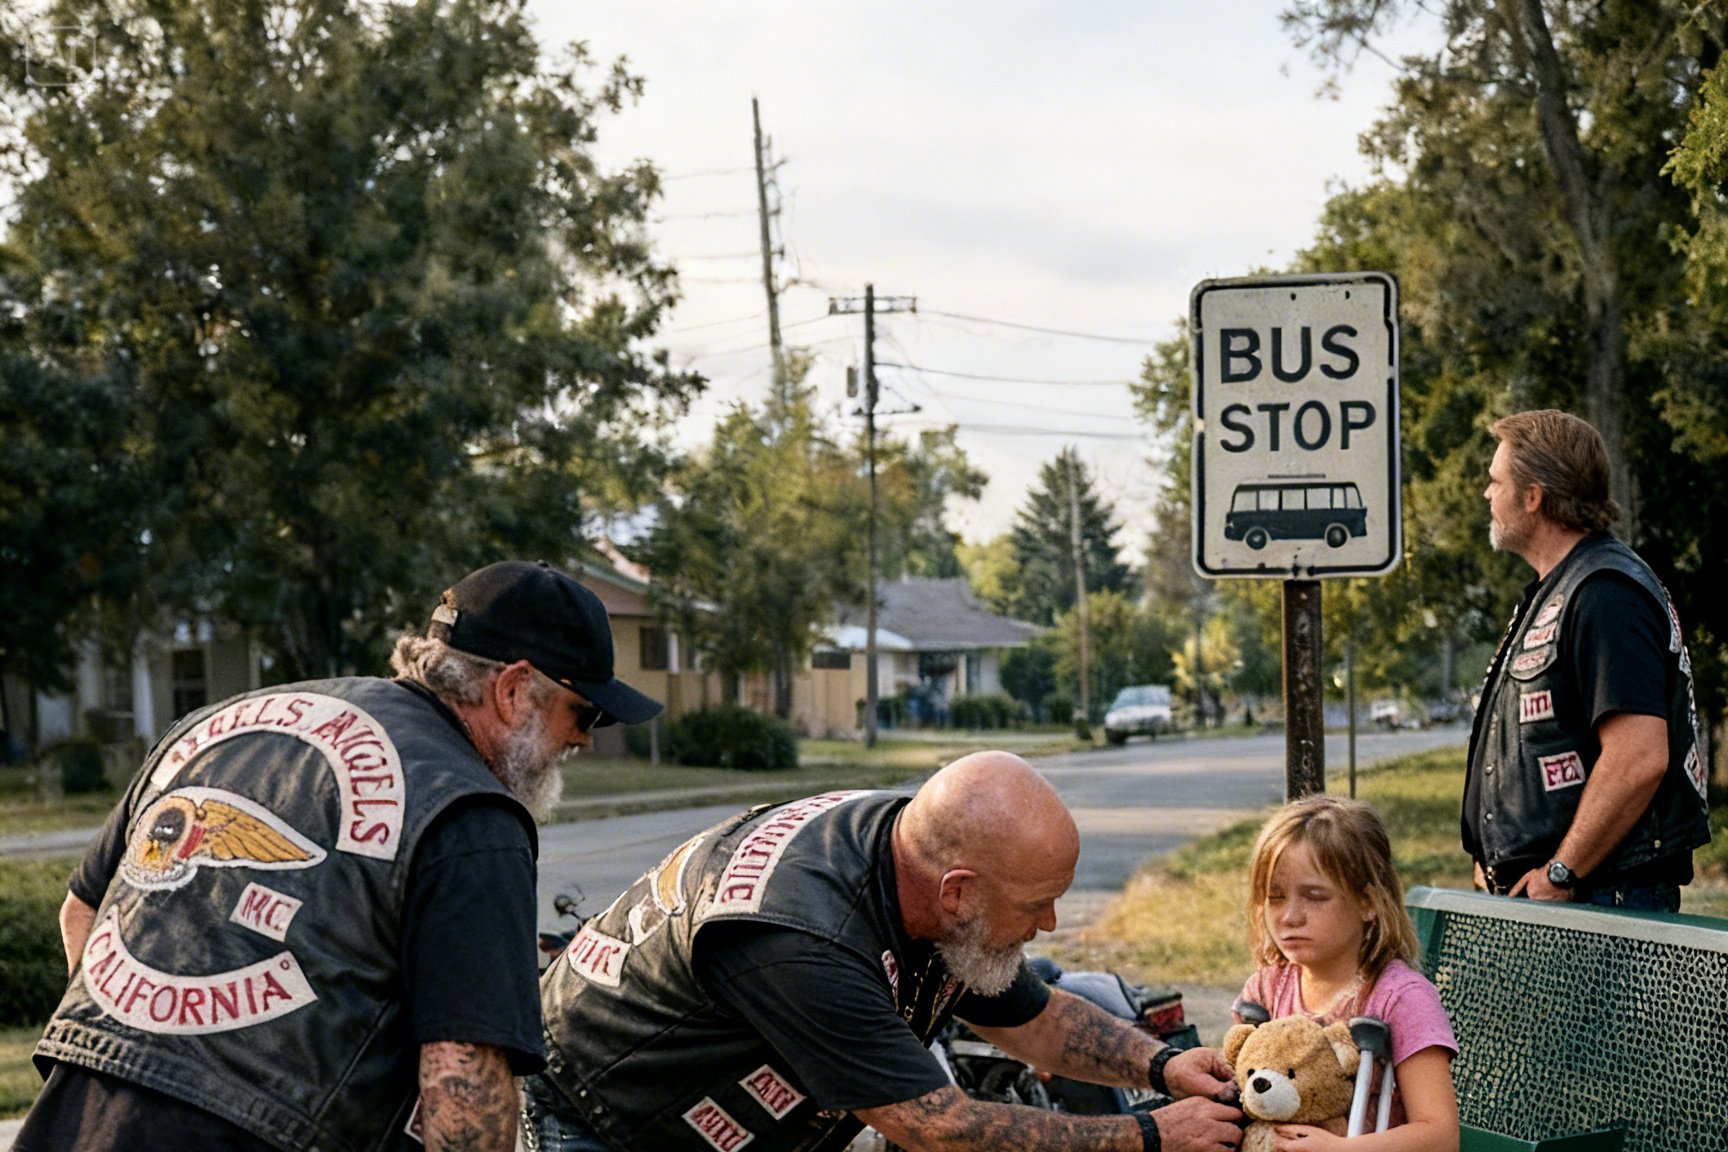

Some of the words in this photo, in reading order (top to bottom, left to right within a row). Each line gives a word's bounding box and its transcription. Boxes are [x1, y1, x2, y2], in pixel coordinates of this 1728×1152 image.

[1220, 324, 1360, 384] BUS
[1220, 400, 1376, 453] STOP
[88, 931, 293, 1026] CALIFORNIA
